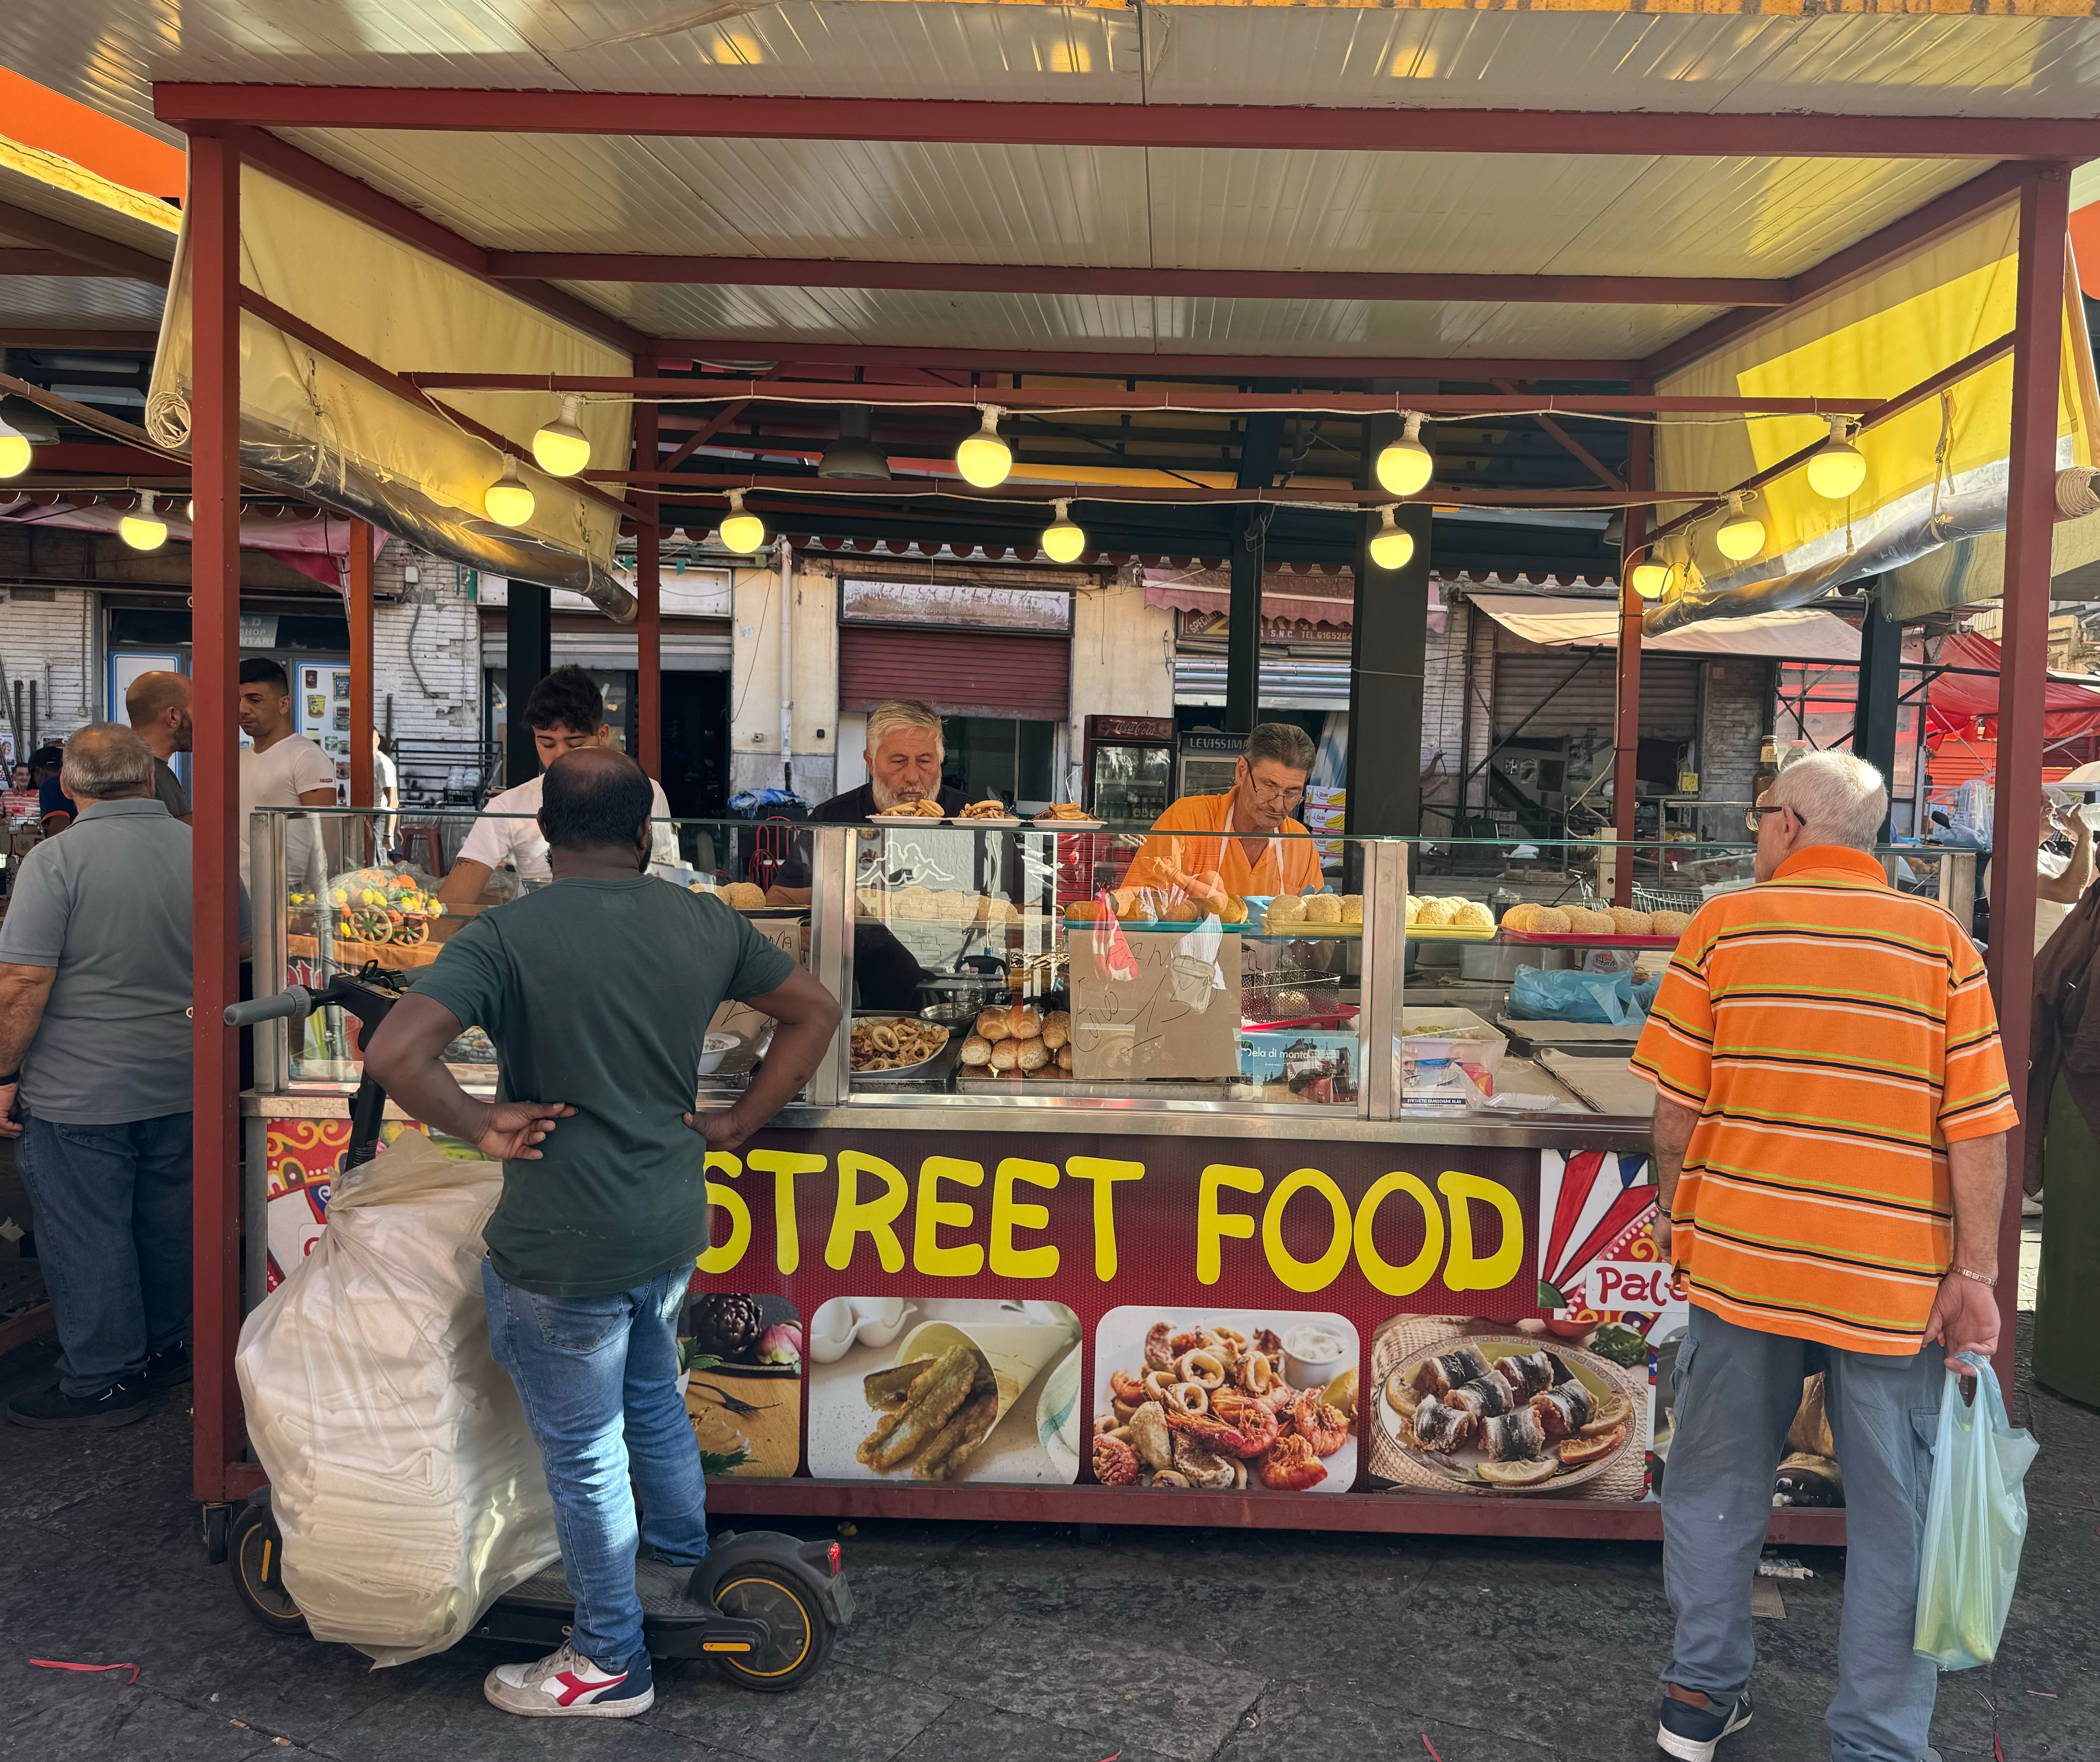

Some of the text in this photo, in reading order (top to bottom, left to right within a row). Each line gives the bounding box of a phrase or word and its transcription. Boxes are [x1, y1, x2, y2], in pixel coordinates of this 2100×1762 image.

[1268, 1047, 1277, 1057] di
[1279, 1050, 1309, 1059] monta
[697, 1149, 1524, 1296] STREET FOOD
